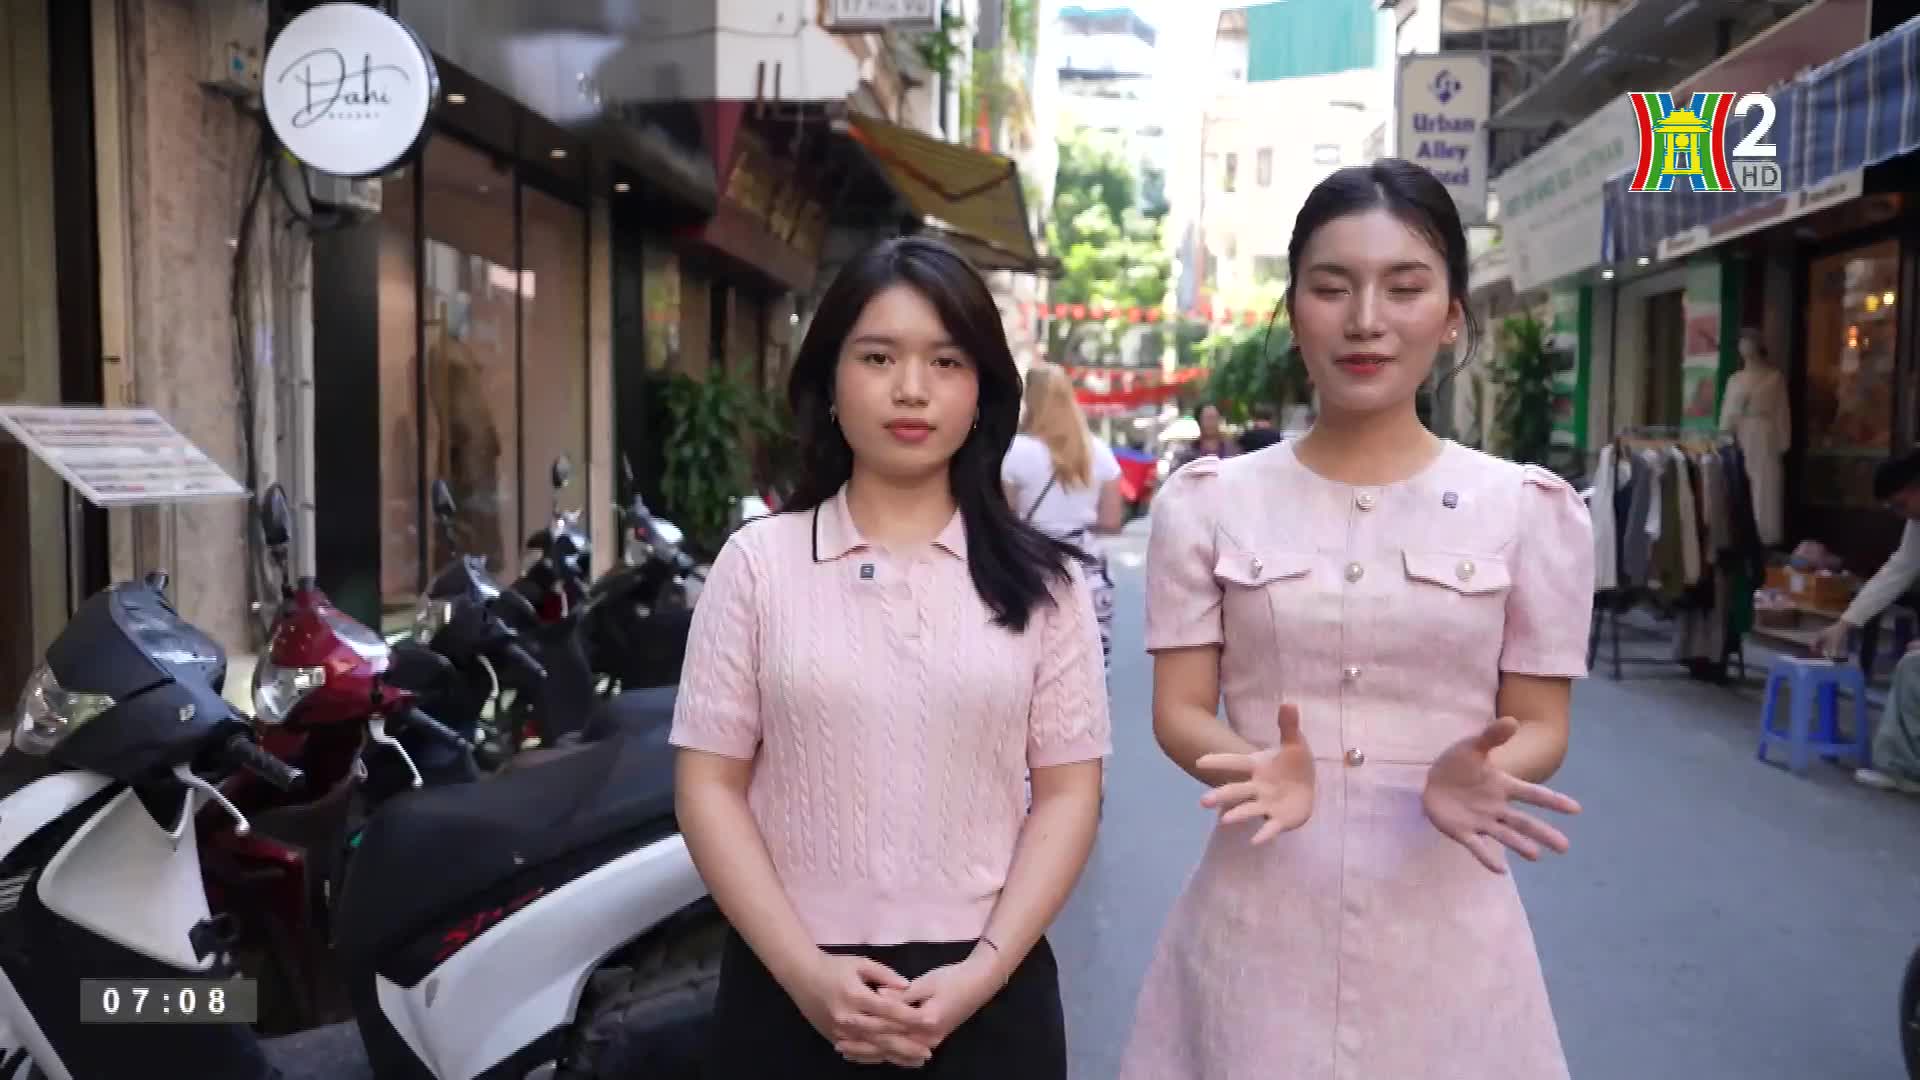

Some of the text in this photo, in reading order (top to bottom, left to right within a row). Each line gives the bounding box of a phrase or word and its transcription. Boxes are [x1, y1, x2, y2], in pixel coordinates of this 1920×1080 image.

[1412, 113, 1475, 133] Urban
[1417, 139, 1468, 162] Alley
[1425, 165, 1469, 185] otel
